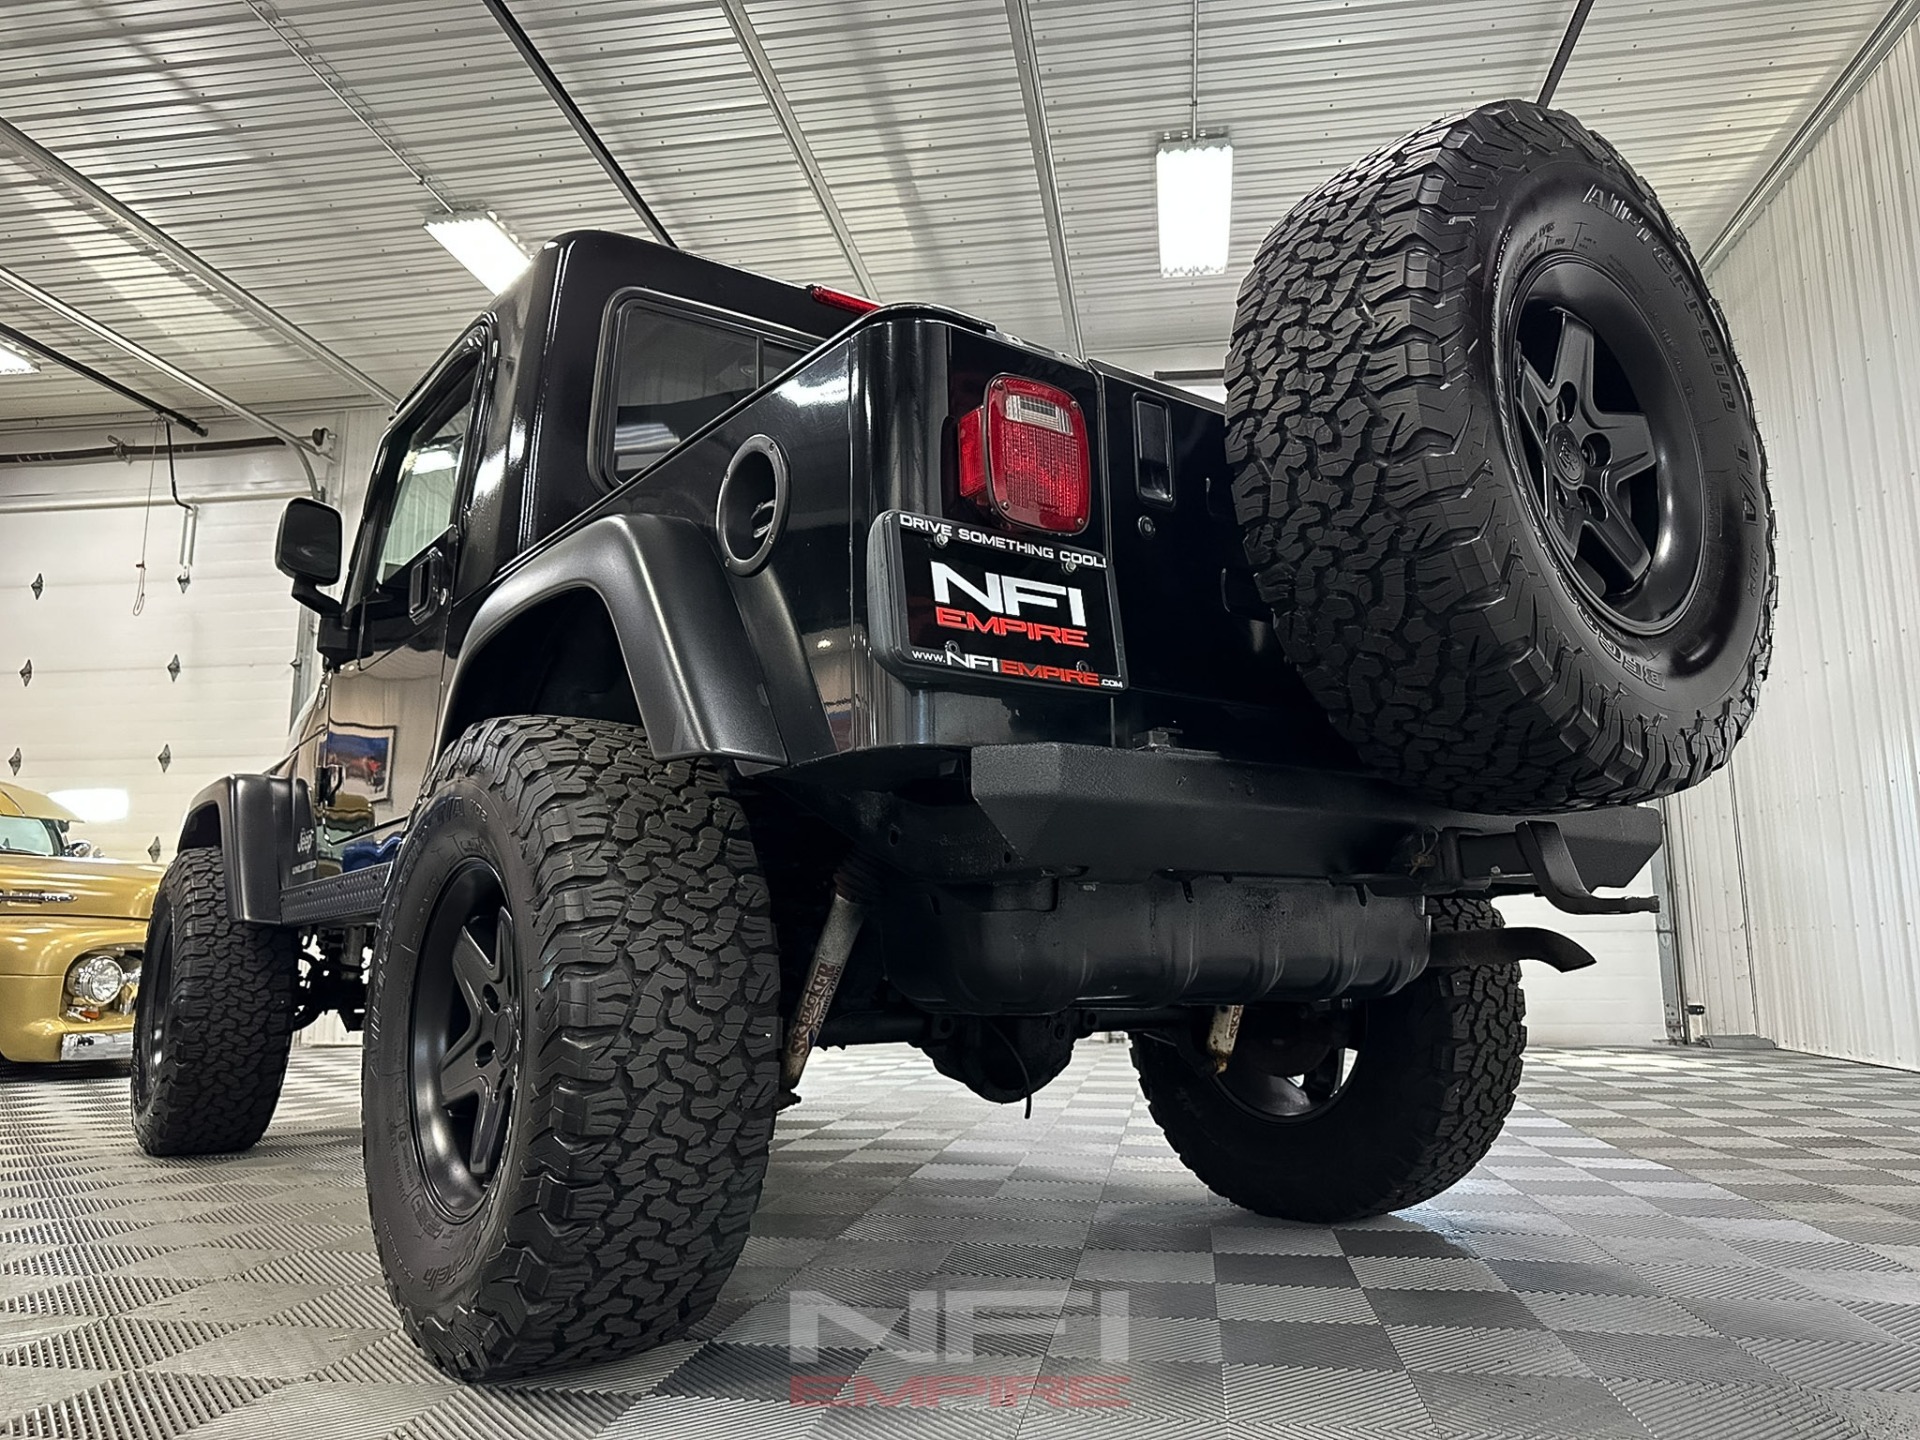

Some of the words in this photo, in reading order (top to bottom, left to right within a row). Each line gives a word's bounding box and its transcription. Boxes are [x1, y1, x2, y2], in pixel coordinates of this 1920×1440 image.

[900, 513, 952, 537] DRIVE
[958, 528, 1054, 559] SOMETHING
[1059, 550, 1107, 569] COOL!
[935, 605, 1090, 648] EMPIRE
[790, 962, 836, 1057] SKYJACKER
